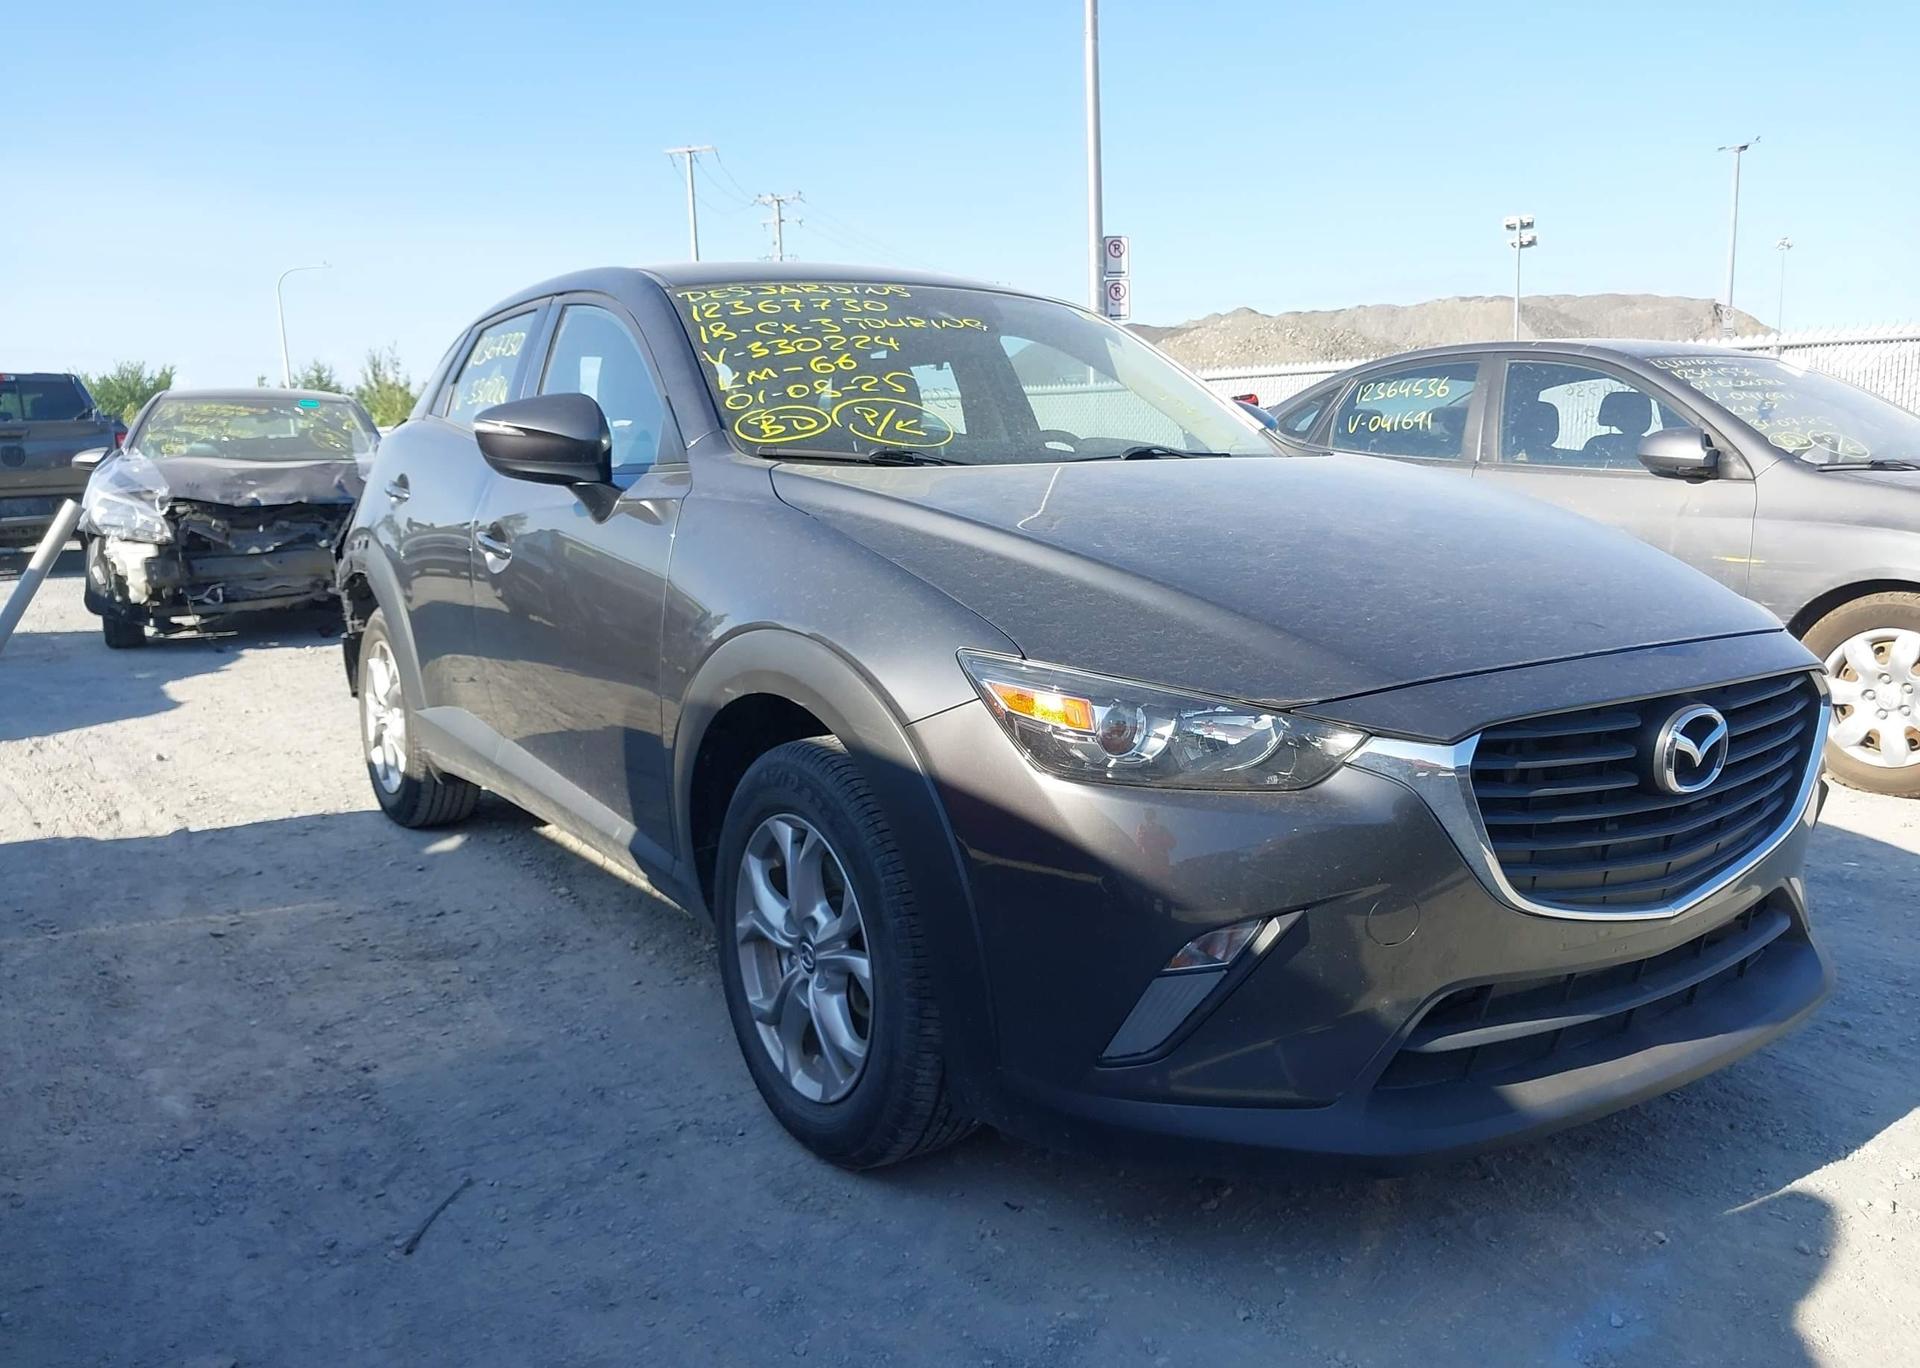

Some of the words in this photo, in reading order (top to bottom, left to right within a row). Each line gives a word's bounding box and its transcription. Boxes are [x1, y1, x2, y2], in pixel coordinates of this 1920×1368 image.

[677, 284, 912, 303] DESJARDINS
[692, 298, 888, 322] 12367730
[702, 335, 901, 366] V-330224
[718, 354, 857, 391] KM-66
[1356, 376, 1450, 404] 12364536
[1348, 411, 1432, 433] V-041691
